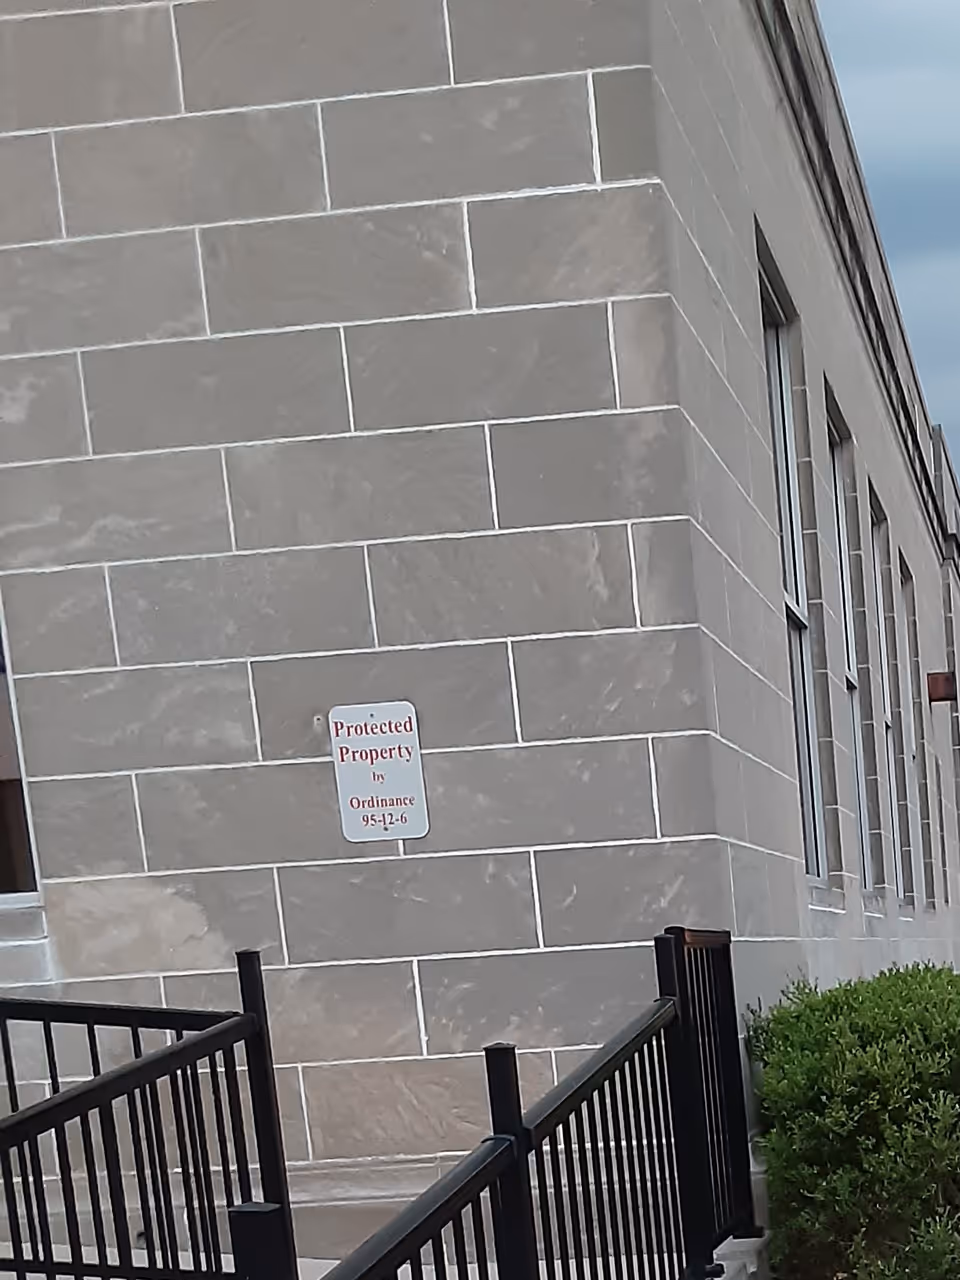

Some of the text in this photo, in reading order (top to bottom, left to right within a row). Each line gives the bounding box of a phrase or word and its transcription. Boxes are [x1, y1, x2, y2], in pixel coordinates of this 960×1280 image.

[333, 716, 414, 738] Protected
[339, 744, 413, 765] Property
[371, 771, 386, 784] by
[349, 795, 416, 809] Ordinance
[361, 812, 408, 827] 95-12-6
